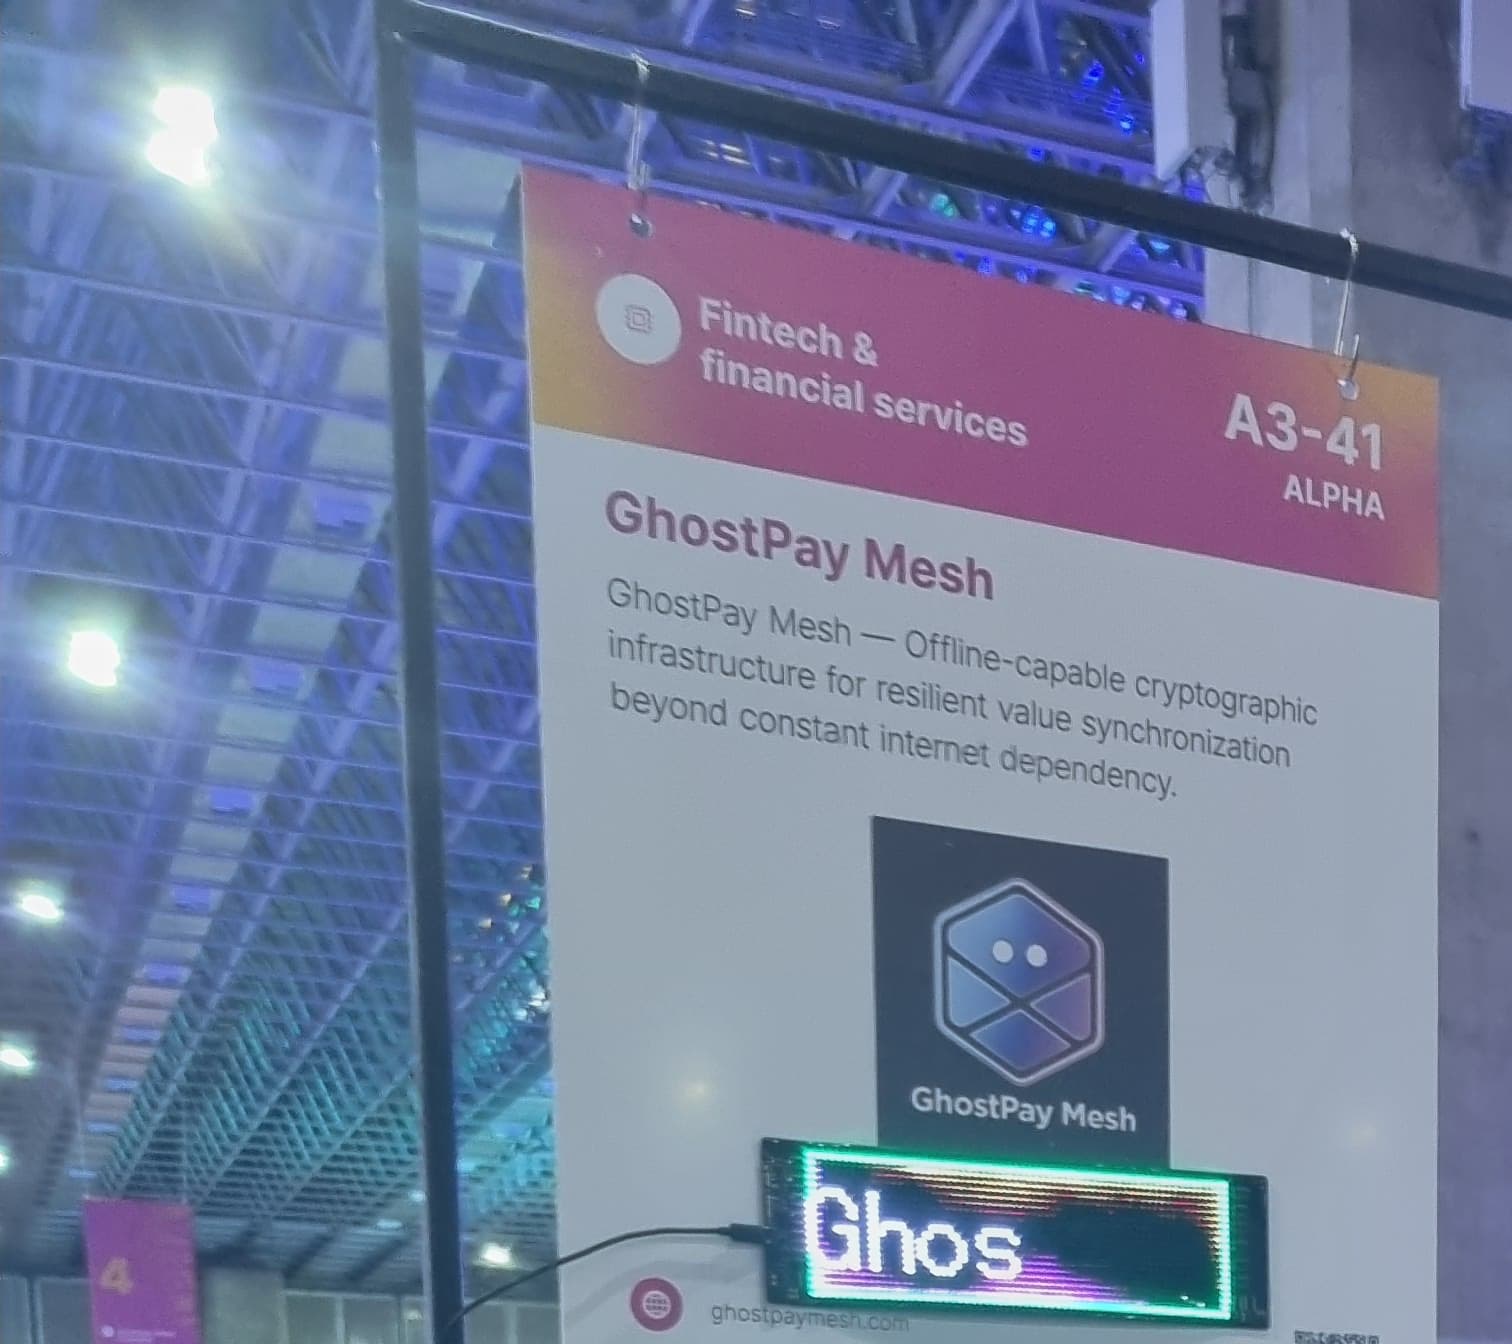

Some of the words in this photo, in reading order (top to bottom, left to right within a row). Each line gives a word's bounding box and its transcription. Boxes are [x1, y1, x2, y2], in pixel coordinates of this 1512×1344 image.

[700, 296, 843, 359] Fintech
[852, 331, 879, 367] &
[700, 346, 864, 414] financial
[873, 391, 1029, 448] services
[1224, 392, 1381, 471] A3-41
[1283, 474, 1385, 521] ALPHA
[605, 490, 850, 582] GhostPay
[864, 537, 995, 600] Mesh
[606, 577, 758, 636] GhostPay
[769, 605, 852, 647] Mesh
[905, 629, 1126, 694] Offline-capable
[1134, 673, 1319, 727] cryptographic
[608, 629, 817, 691] infrastructure
[827, 663, 867, 698] for
[876, 678, 989, 720] resilient
[999, 699, 1072, 733] value
[1081, 714, 1291, 769] synchronization
[610, 681, 728, 727] beyond
[739, 707, 871, 751] constant
[880, 724, 992, 769] internet
[1000, 744, 1178, 801] dependency.
[911, 1086, 1054, 1130] GhostPay
[1061, 1101, 1138, 1133] Mesh
[101, 1257, 133, 1294] 4
[804, 1185, 1024, 1282] Ghos
[711, 1302, 910, 1333] ghostpaymesh.com
